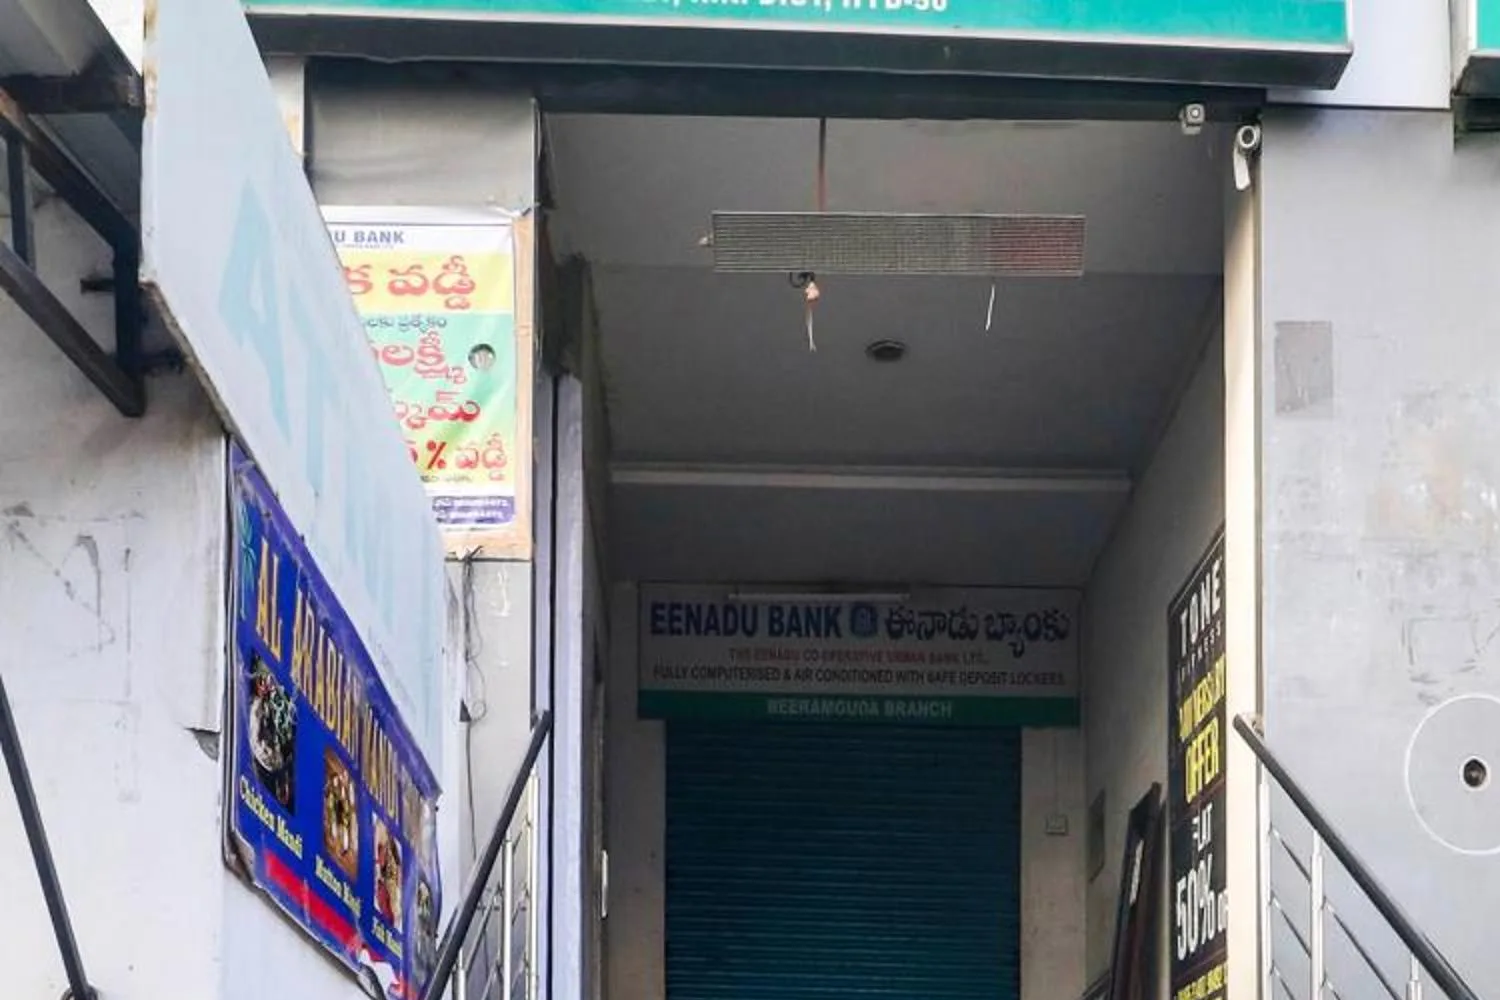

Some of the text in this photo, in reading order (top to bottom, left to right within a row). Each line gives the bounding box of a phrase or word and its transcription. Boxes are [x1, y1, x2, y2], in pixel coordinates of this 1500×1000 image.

[354, 231, 404, 244] BANK
[651, 602, 758, 637] EENADU
[768, 604, 841, 638] BANK
[885, 607, 978, 641] ఈనాడు
[1181, 557, 1221, 658] TONE
[255, 536, 283, 663] AL
[290, 587, 359, 768] ARABIAN
[653, 666, 688, 680] FULLY
[793, 668, 814, 682] AIR
[815, 668, 892, 684] CONDITIONED
[896, 669, 925, 684] WITH
[885, 701, 952, 717] BRANCH
[1185, 716, 1219, 803] OFFER
[1176, 853, 1215, 961] 50%
